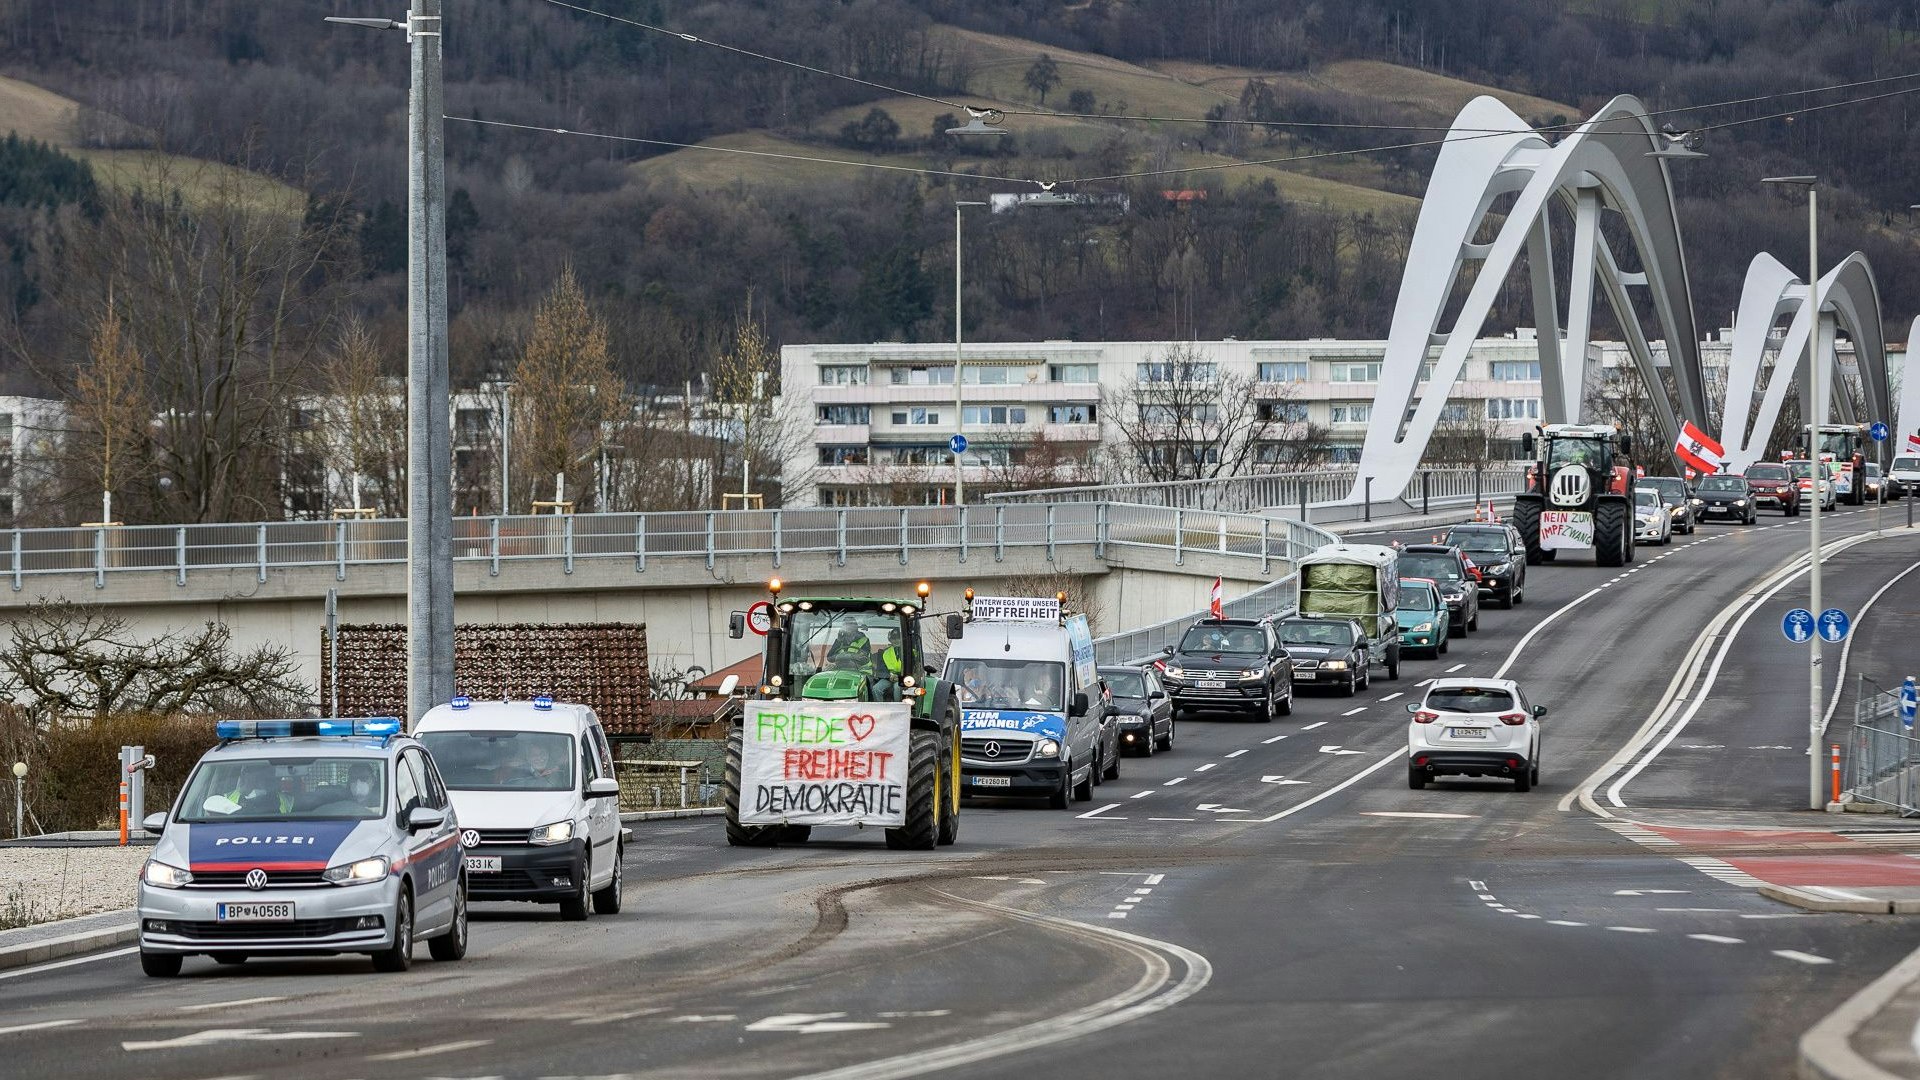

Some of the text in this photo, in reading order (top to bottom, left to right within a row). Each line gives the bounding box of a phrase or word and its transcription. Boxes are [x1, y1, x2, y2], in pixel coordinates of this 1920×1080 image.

[1544, 512, 1590, 523] NEIN ZUM
[1541, 524, 1592, 545] IMPFZWANG
[974, 598, 1016, 606] UNTERWEGS
[1017, 599, 1030, 607] FÜR
[968, 712, 999, 720] ZUM
[757, 712, 845, 743] FRIEDE
[785, 748, 894, 779] FREIHEIT
[755, 783, 902, 815] DEMOKRATIE
[215, 836, 315, 846] POLIZEI
[484, 859, 493, 869] IK
[229, 905, 289, 918] BP 40568
